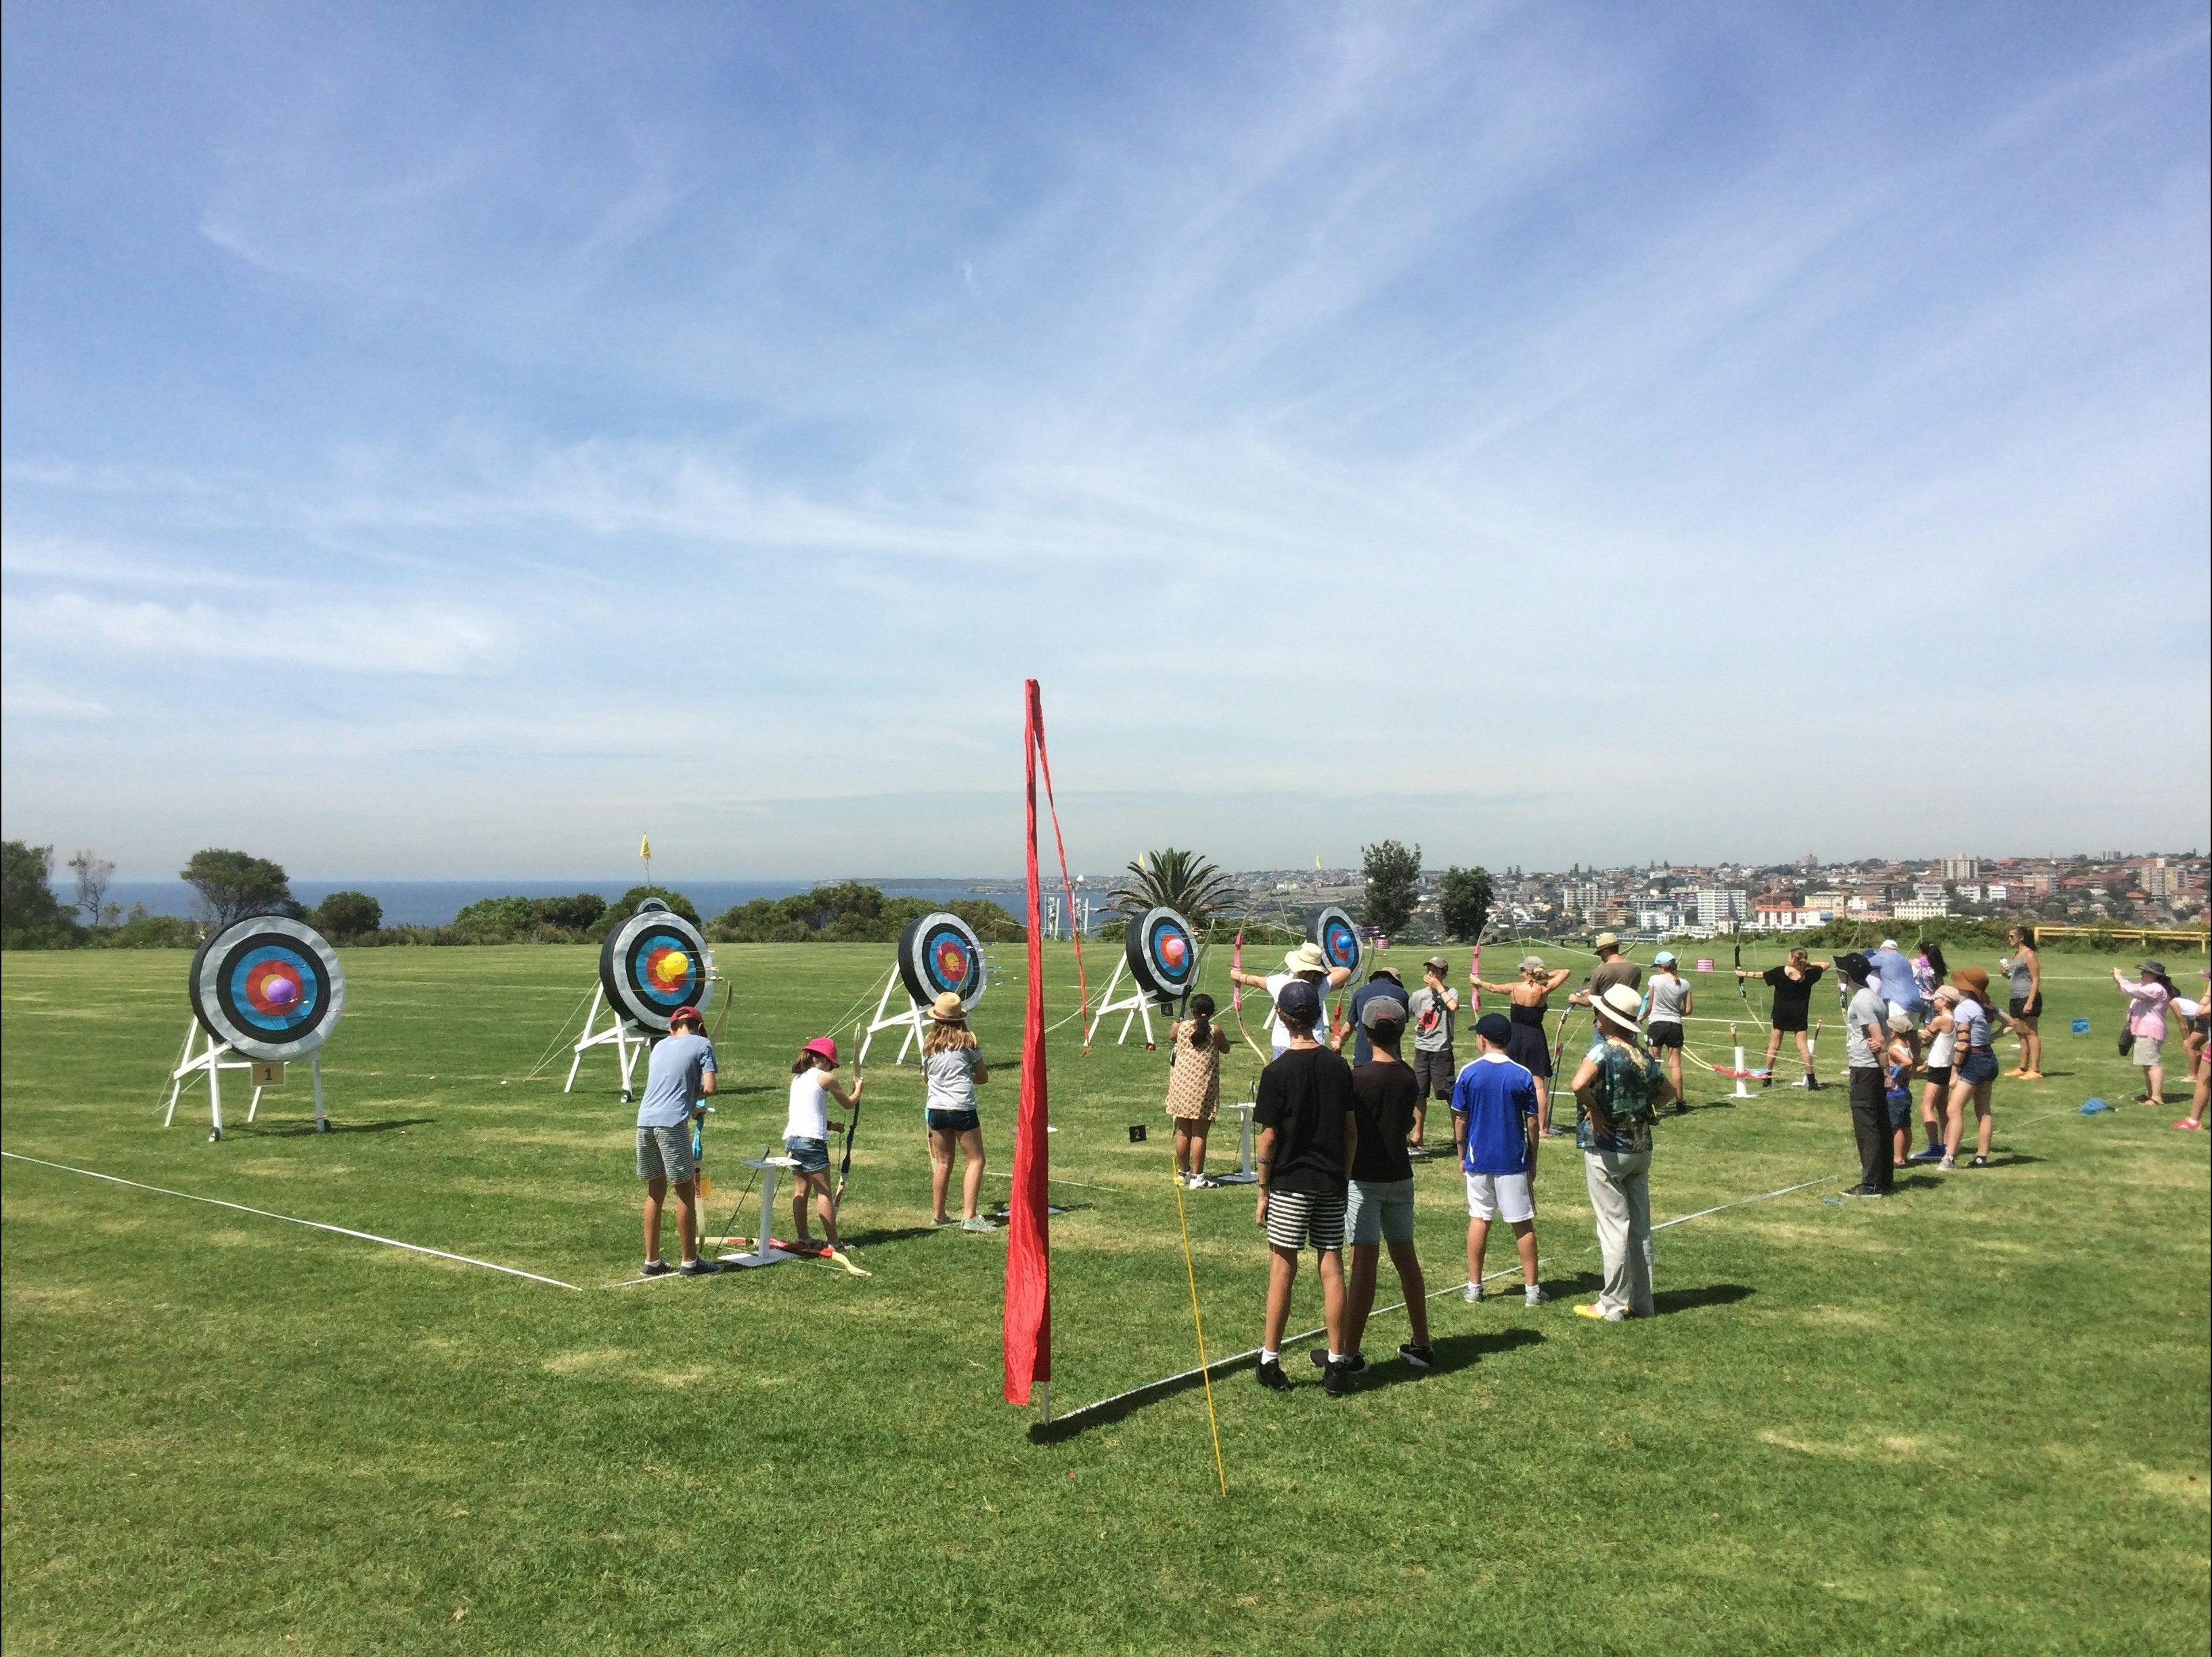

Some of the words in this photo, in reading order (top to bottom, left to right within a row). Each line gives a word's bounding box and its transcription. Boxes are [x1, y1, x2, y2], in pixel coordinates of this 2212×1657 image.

[1165, 1005, 1170, 1015] 4
[265, 1067, 273, 1080] 1
[1134, 1128, 1141, 1139] 2
